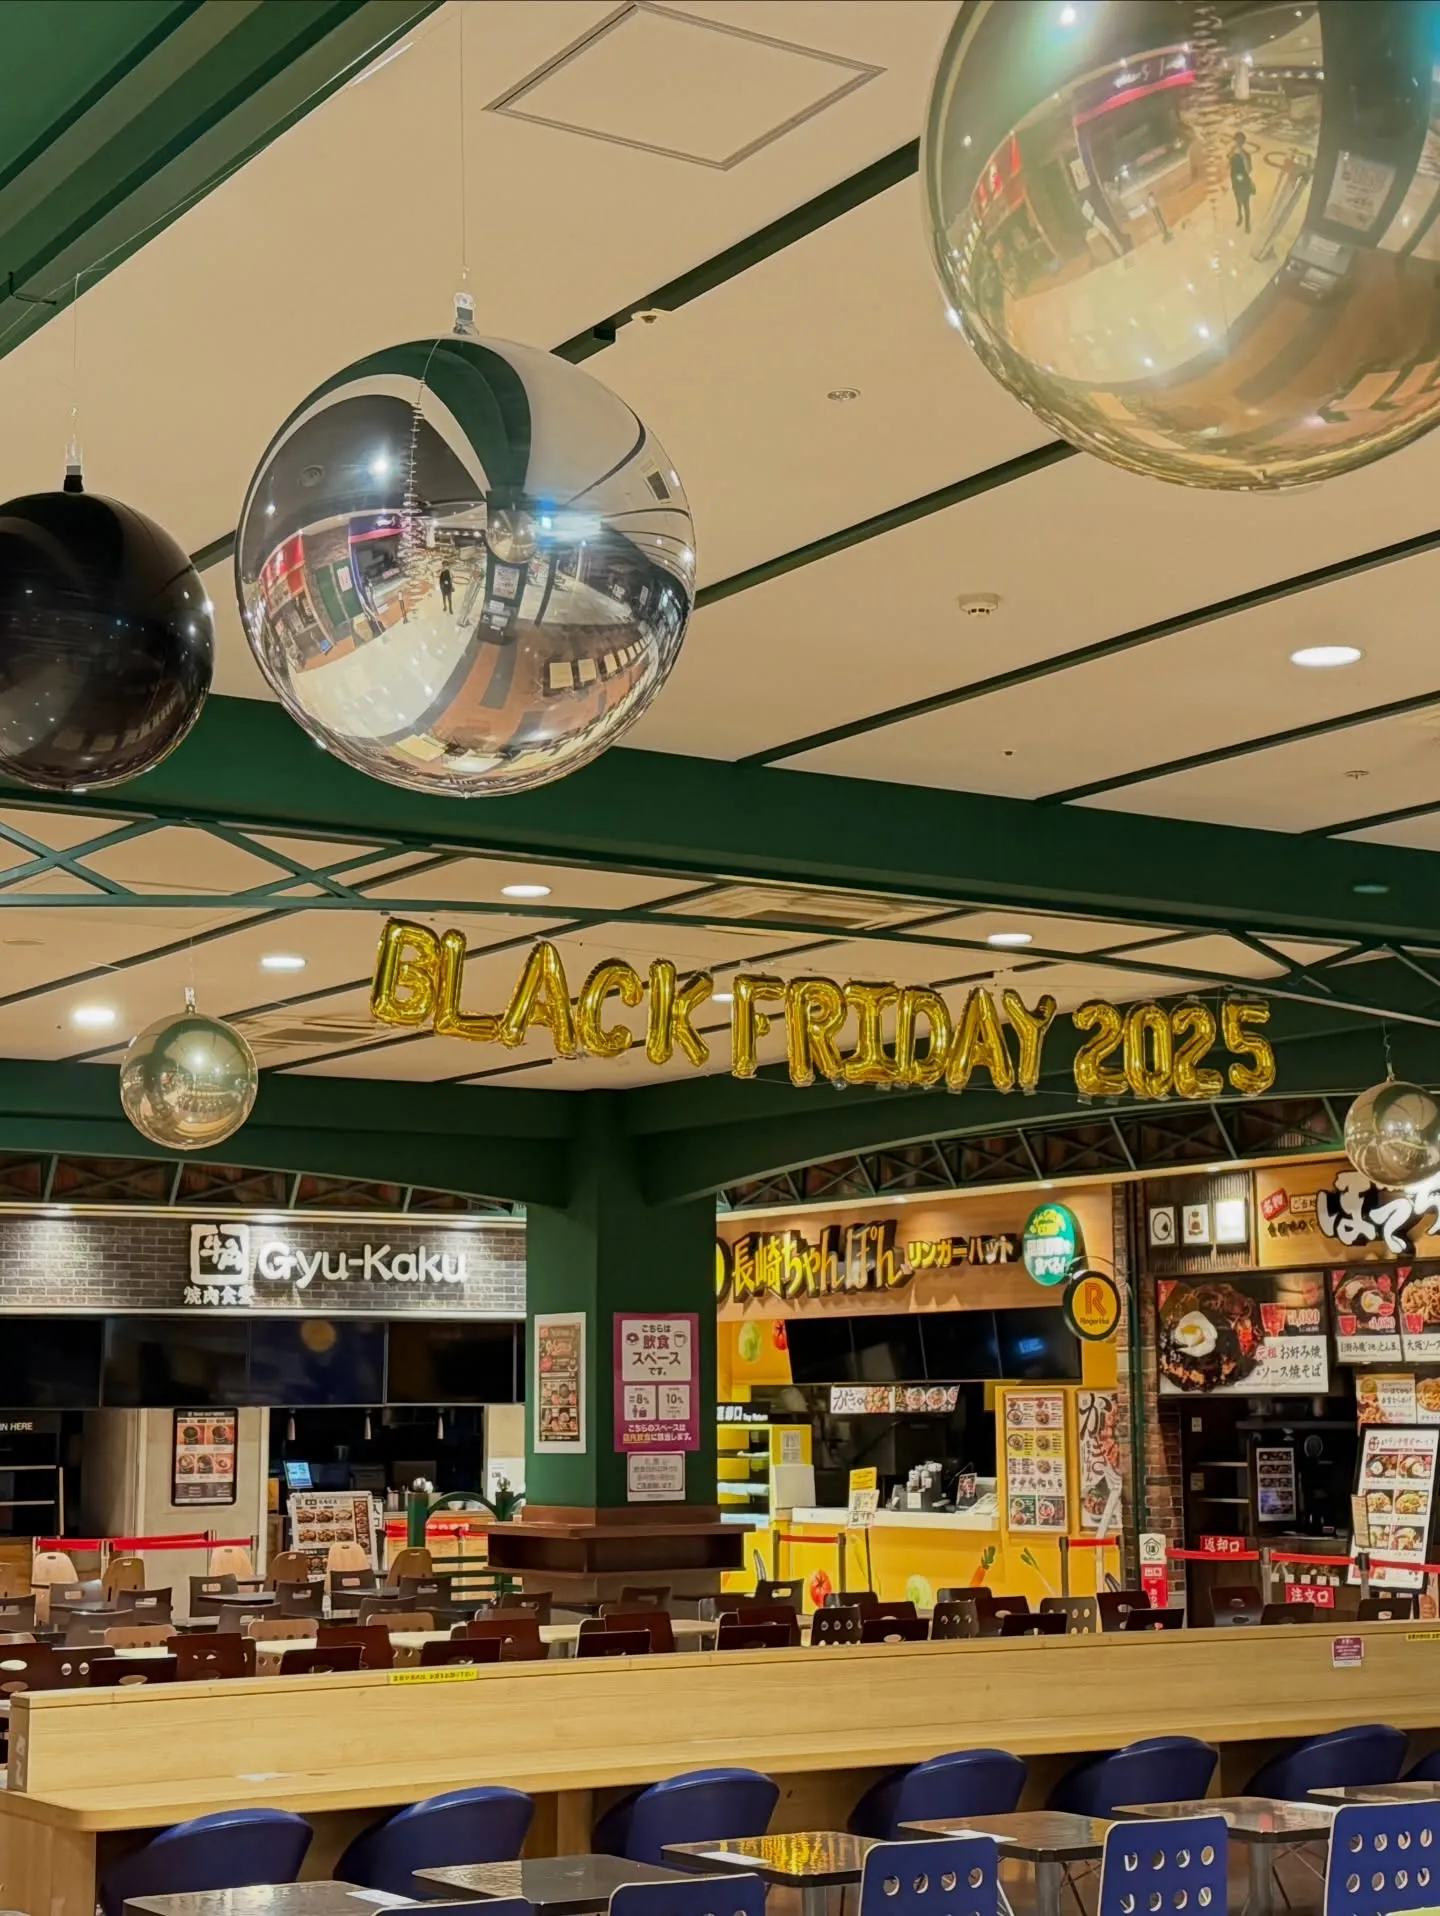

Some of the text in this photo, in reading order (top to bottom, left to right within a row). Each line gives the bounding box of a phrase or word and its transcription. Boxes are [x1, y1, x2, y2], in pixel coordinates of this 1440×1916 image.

[371, 916, 1277, 1101] BLACK FRIDAY 2025
[908, 1235, 1014, 1268] リンガーハット
[258, 1242, 467, 1289] Gyu-Kaku
[733, 1222, 905, 1299] 長崎ちゃんぽん
[1084, 1282, 1107, 1317] R
[642, 1324, 671, 1333] こちらは
[643, 1335, 670, 1349] 飲食
[632, 1352, 681, 1365] スペース
[1280, 1345, 1322, 1360] お好み焼
[648, 1367, 667, 1376] です。
[10, 1422, 33, 1430] HERE
[1204, 1537, 1240, 1553] 返却口
[1291, 1587, 1329, 1604] 注文口
